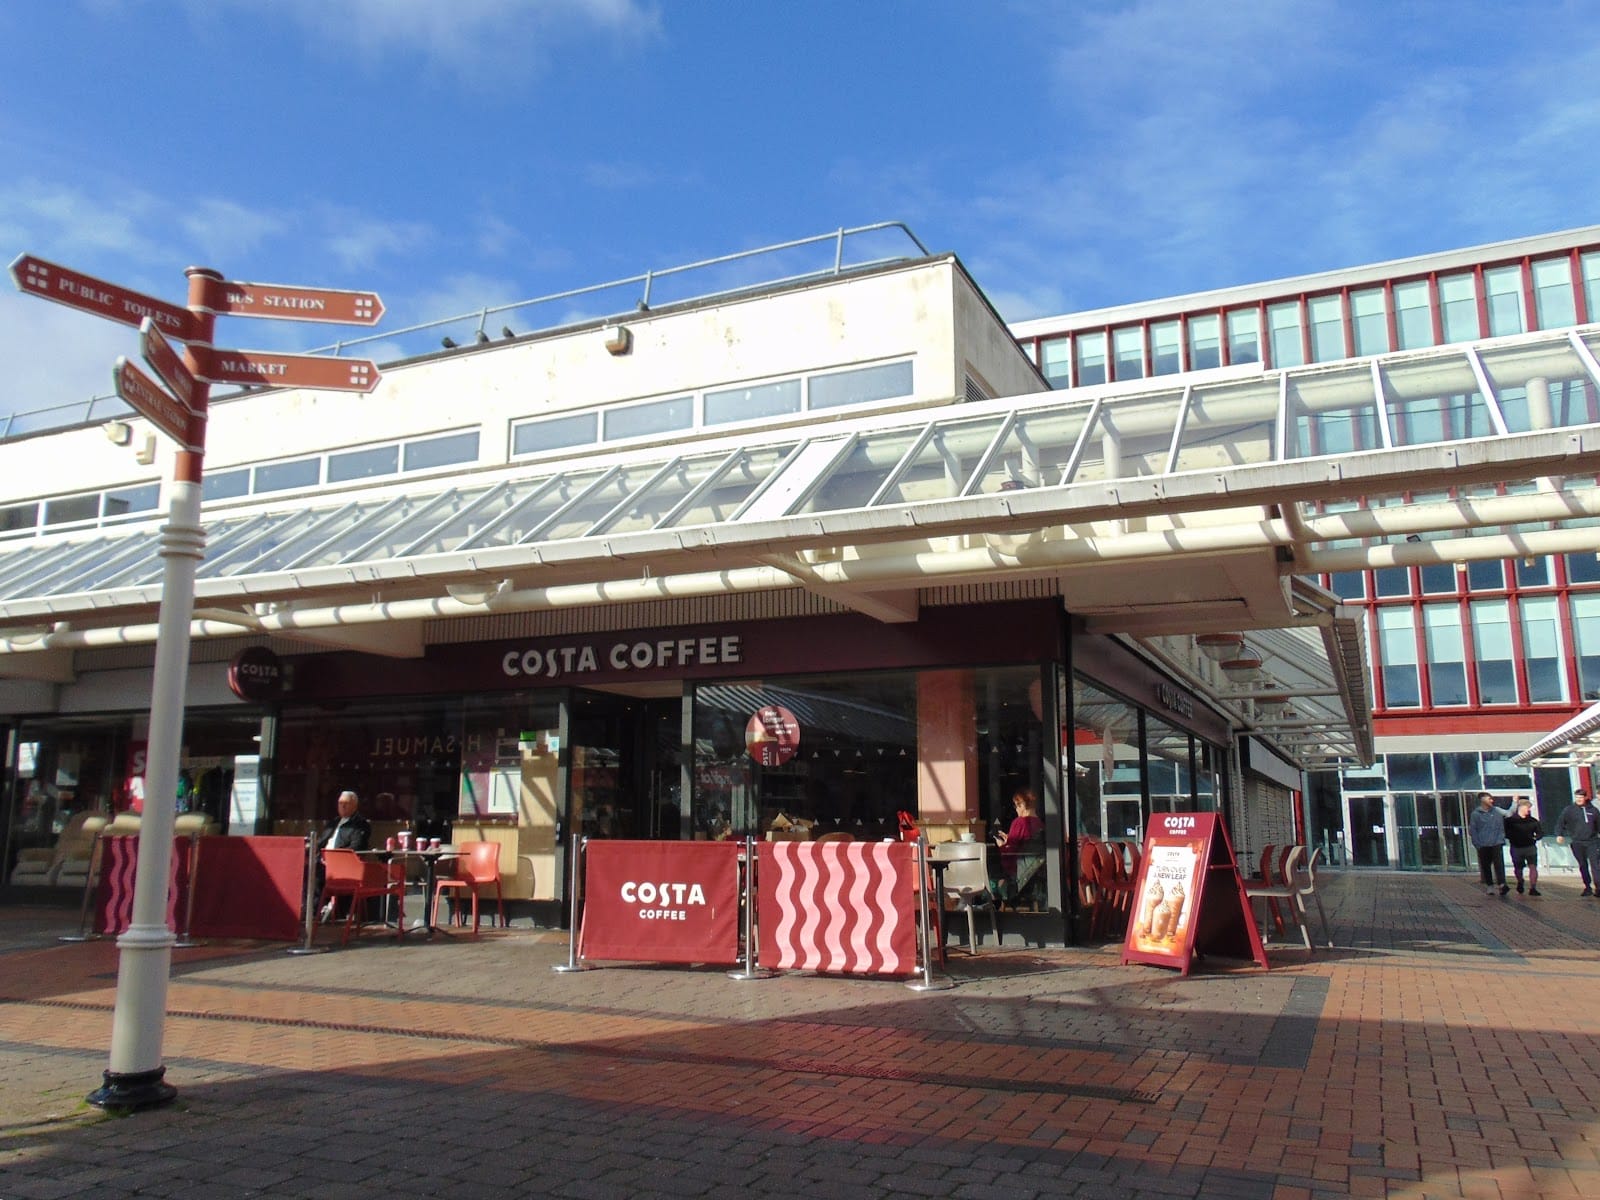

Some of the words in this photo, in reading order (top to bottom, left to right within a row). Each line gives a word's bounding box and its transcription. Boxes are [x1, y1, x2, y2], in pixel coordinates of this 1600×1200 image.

[58, 277, 115, 306] PUBLIC
[122, 299, 182, 328] TOILETS
[226, 292, 255, 304] BUS
[263, 295, 325, 310] STATION
[221, 360, 287, 376] MARKET
[502, 646, 598, 678] COSTA
[610, 635, 740, 670] COFFEE
[241, 664, 278, 677] COSTA
[1164, 816, 1195, 828] COSTA
[620, 881, 706, 908] COSTA
[639, 909, 686, 920] COFFEE
